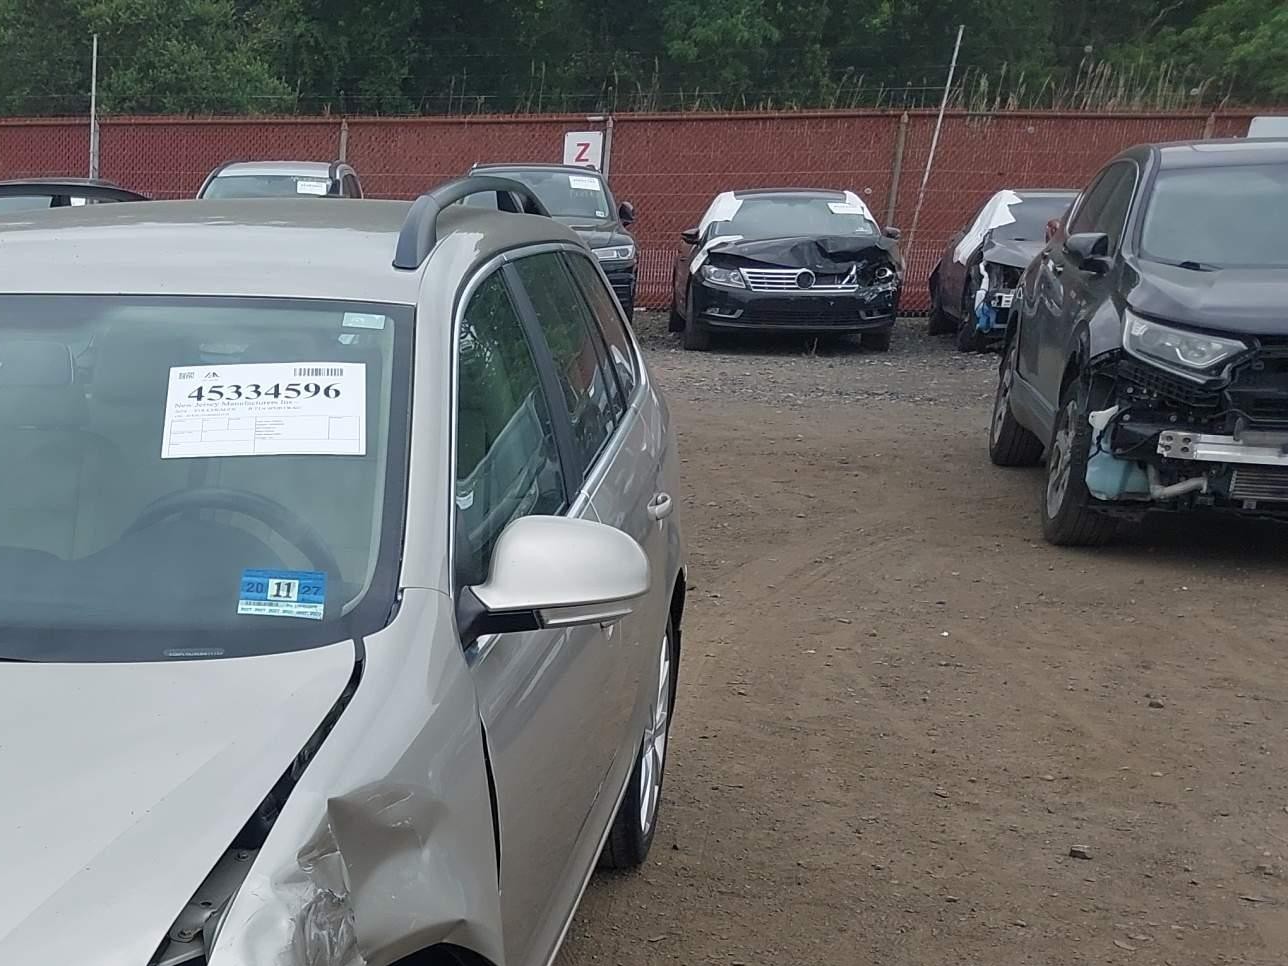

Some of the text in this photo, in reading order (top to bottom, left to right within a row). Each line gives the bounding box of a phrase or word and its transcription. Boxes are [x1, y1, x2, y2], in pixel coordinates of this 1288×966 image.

[575, 143, 591, 162] Z
[188, 383, 341, 401] 45334596
[246, 581, 321, 598] 20 11 27
